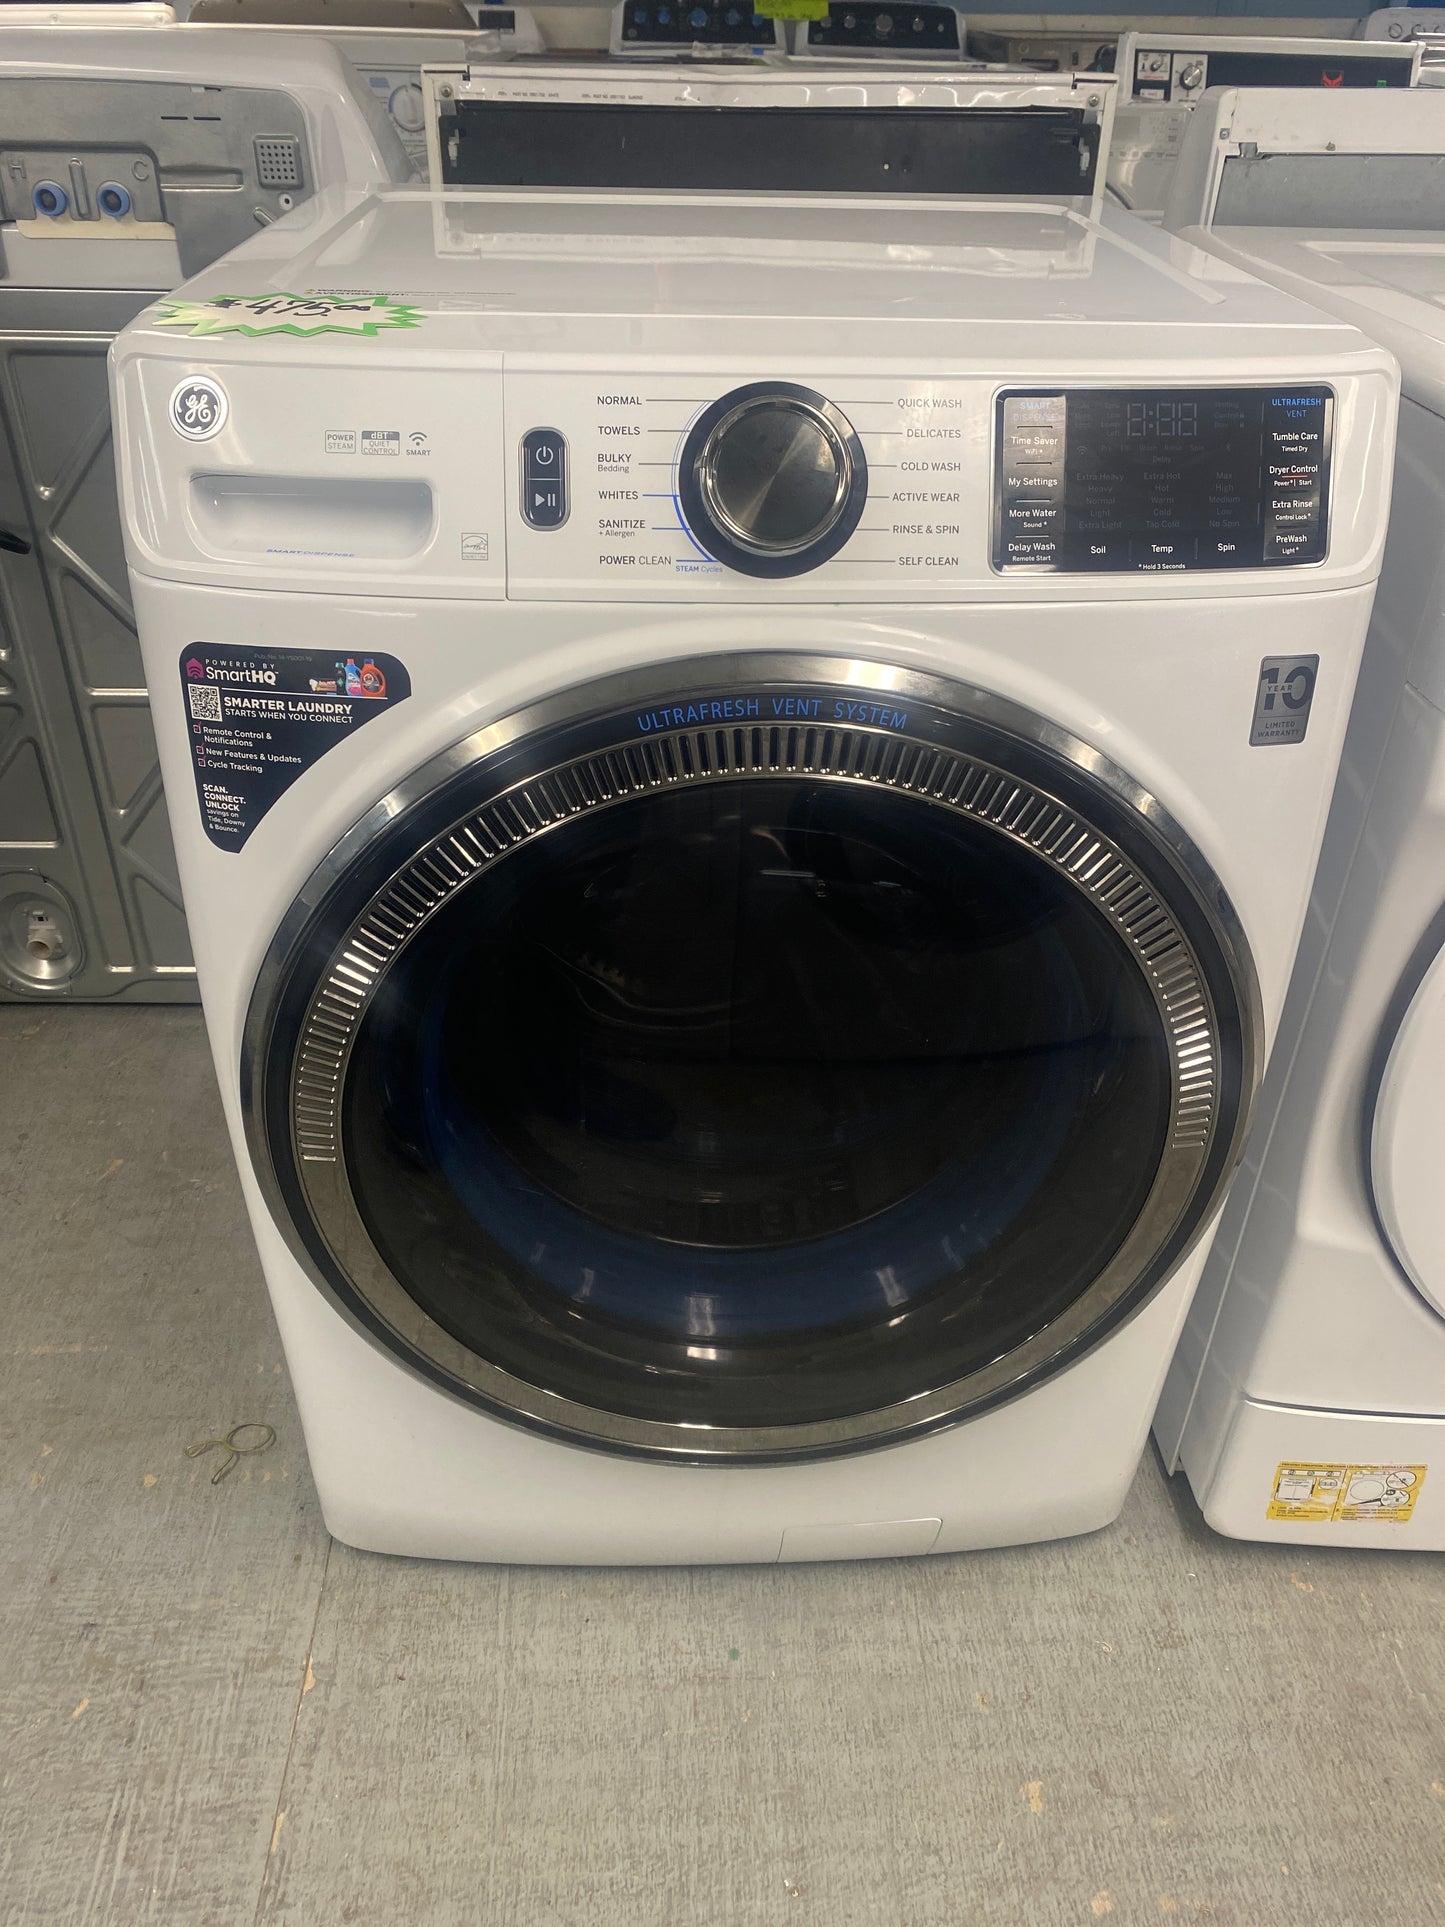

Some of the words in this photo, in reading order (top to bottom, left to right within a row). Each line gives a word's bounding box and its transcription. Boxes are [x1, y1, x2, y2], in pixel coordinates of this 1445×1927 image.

[131, 160, 150, 182] C
[598, 396, 642, 405] NORMAL
[898, 398, 930, 409] QUICK
[932, 399, 962, 408] WASH
[1272, 398, 1321, 406] ULTRAFRESH
[1013, 413, 1056, 422] DISPENSE
[1286, 410, 1308, 418] VENT
[598, 426, 640, 435] TOWELS
[906, 428, 961, 438] DELICATES
[1011, 436, 1031, 445] Time
[1034, 436, 1058, 445] Saver
[1272, 432, 1299, 441] Tumble
[1300, 432, 1318, 440] Care
[597, 453, 632, 462] BULKY
[597, 465, 630, 473] Bedding
[901, 462, 928, 471] COLD
[931, 462, 961, 471] WASH
[1270, 466, 1290, 475] Dryer
[1291, 464, 1318, 473] Control
[1008, 478, 1021, 487] My
[1023, 477, 1058, 487] Settings
[598, 490, 638, 500] WHITES
[892, 492, 928, 502] ACTIVE
[931, 493, 960, 502] WEAR
[1272, 501, 1291, 509] Extra
[1293, 500, 1313, 508] Rinse
[1009, 509, 1030, 518] More
[1032, 509, 1057, 517] Water
[598, 520, 646, 529] SANITIZE
[893, 525, 923, 534] RINSE
[925, 525, 933, 534] &
[935, 525, 960, 534] SPIN
[605, 530, 635, 538] Allergen
[1276, 535, 1307, 543] PreWash
[1008, 543, 1031, 552] Delay
[1033, 542, 1056, 551] Wash
[1090, 546, 1106, 554] Soil
[1152, 544, 1174, 554] Temp
[1217, 542, 1236, 552] Spin
[599, 555, 635, 565] POWER
[638, 556, 672, 565] CLEAN
[899, 556, 923, 566] SELF
[925, 557, 959, 566] CLEAN
[205, 659, 255, 668] POWERED
[1260, 666, 1316, 710] 10
[224, 696, 285, 710] SMARTER
[288, 701, 352, 714] LAUNDRY
[225, 709, 257, 718] STARTS
[258, 711, 286, 720] WHEN
[288, 713, 307, 721] YOU
[309, 714, 353, 723] CONNECT
[637, 699, 759, 732] ULTRAFRESH
[772, 698, 822, 716] VENT
[833, 702, 907, 729] SYSTEM
[1265, 721, 1295, 729] LIMITED
[203, 727, 232, 736] Remote
[234, 730, 264, 739] Control
[1258, 729, 1299, 738] WARRANTY
[204, 735, 253, 747] Notifications
[206, 748, 222, 756] New
[224, 750, 258, 760] Features
[268, 754, 302, 764] Updates
[207, 760, 228, 769] Cycle
[229, 762, 263, 774] Tracking
[203, 784, 229, 794] SCAN.
[204, 792, 246, 804] CONNECT.
[205, 800, 240, 812] UNLOCK
[206, 809, 229, 817] savings
[224, 818, 246, 827] Downy
